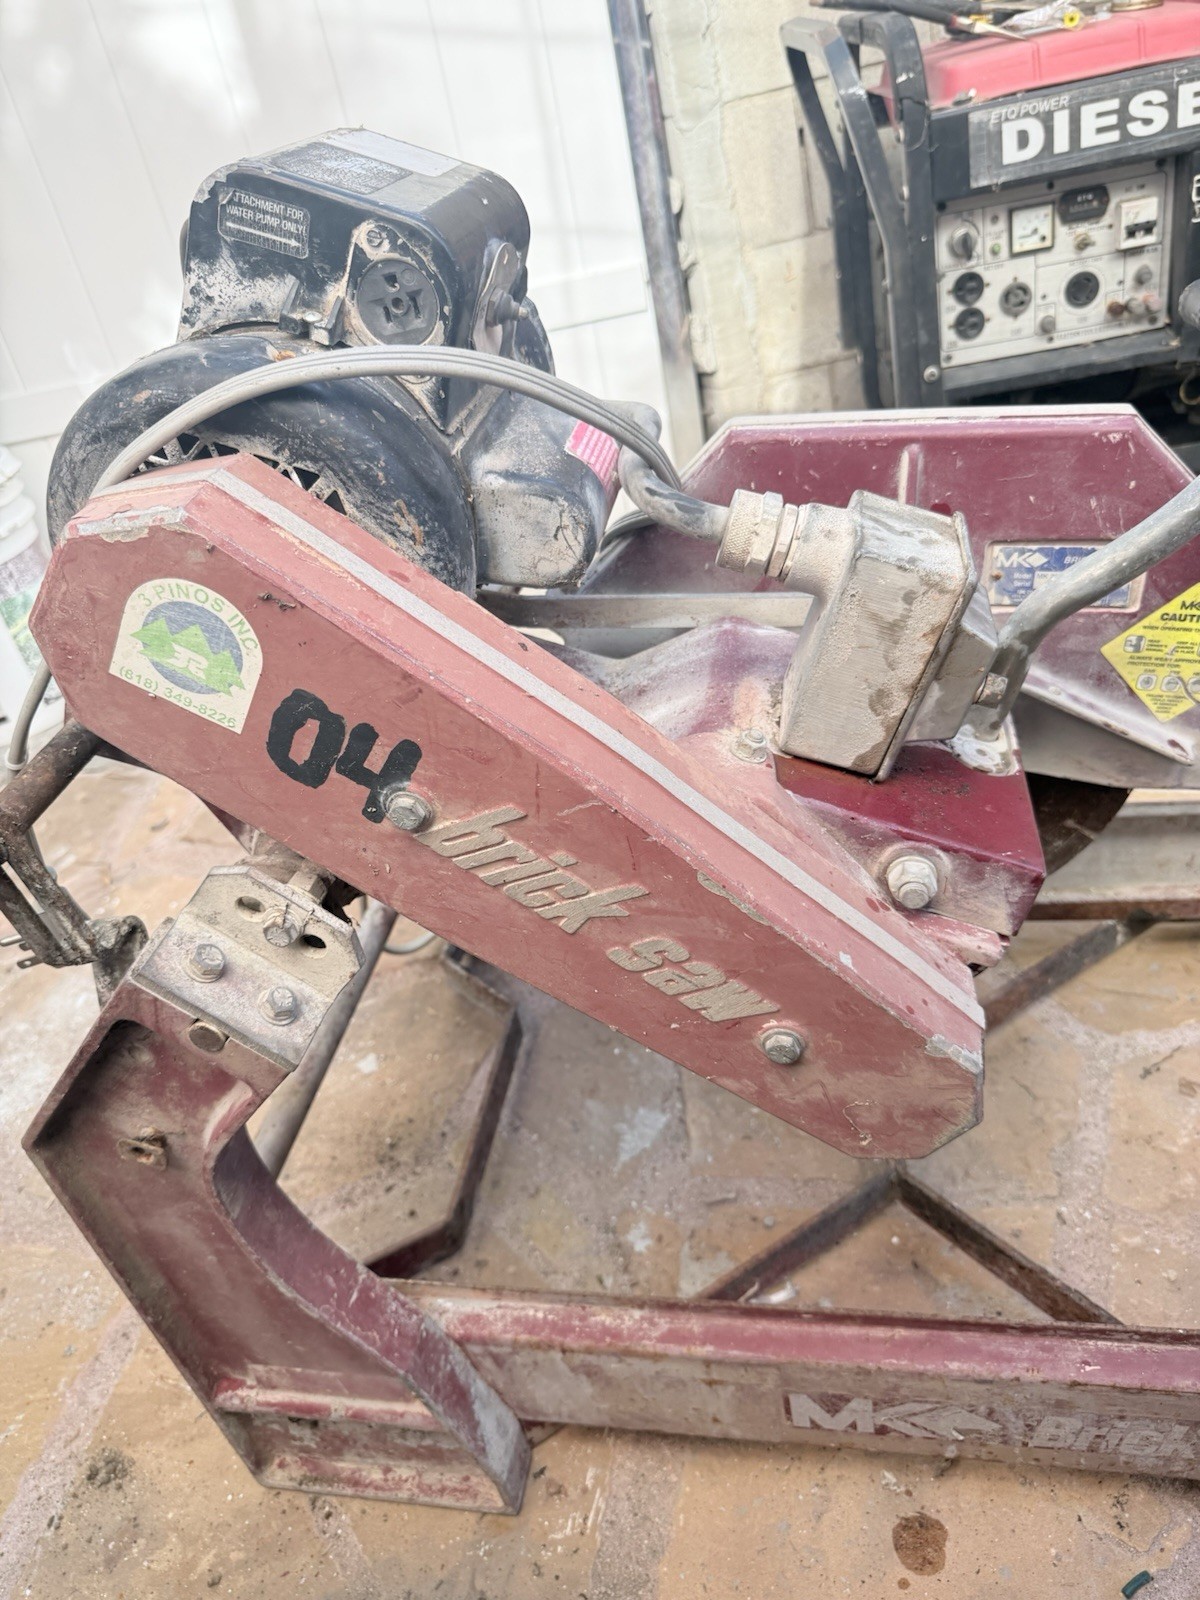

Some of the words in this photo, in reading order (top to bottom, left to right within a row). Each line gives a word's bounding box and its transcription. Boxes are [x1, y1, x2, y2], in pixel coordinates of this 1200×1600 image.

[989, 106, 1017, 125] ETQ
[1019, 94, 1071, 118] POWER
[226, 204, 254, 220] WATER
[255, 212, 281, 228] PUMP
[286, 207, 304, 221] FOR
[137, 592, 153, 608] 3
[152, 583, 226, 613] PINOS
[228, 613, 259, 651] INC
[119, 666, 159, 692] (818)
[163, 687, 237, 729] 349-8226
[266, 689, 422, 824] 04
[414, 805, 651, 935] brick
[605, 937, 781, 1023] saw
